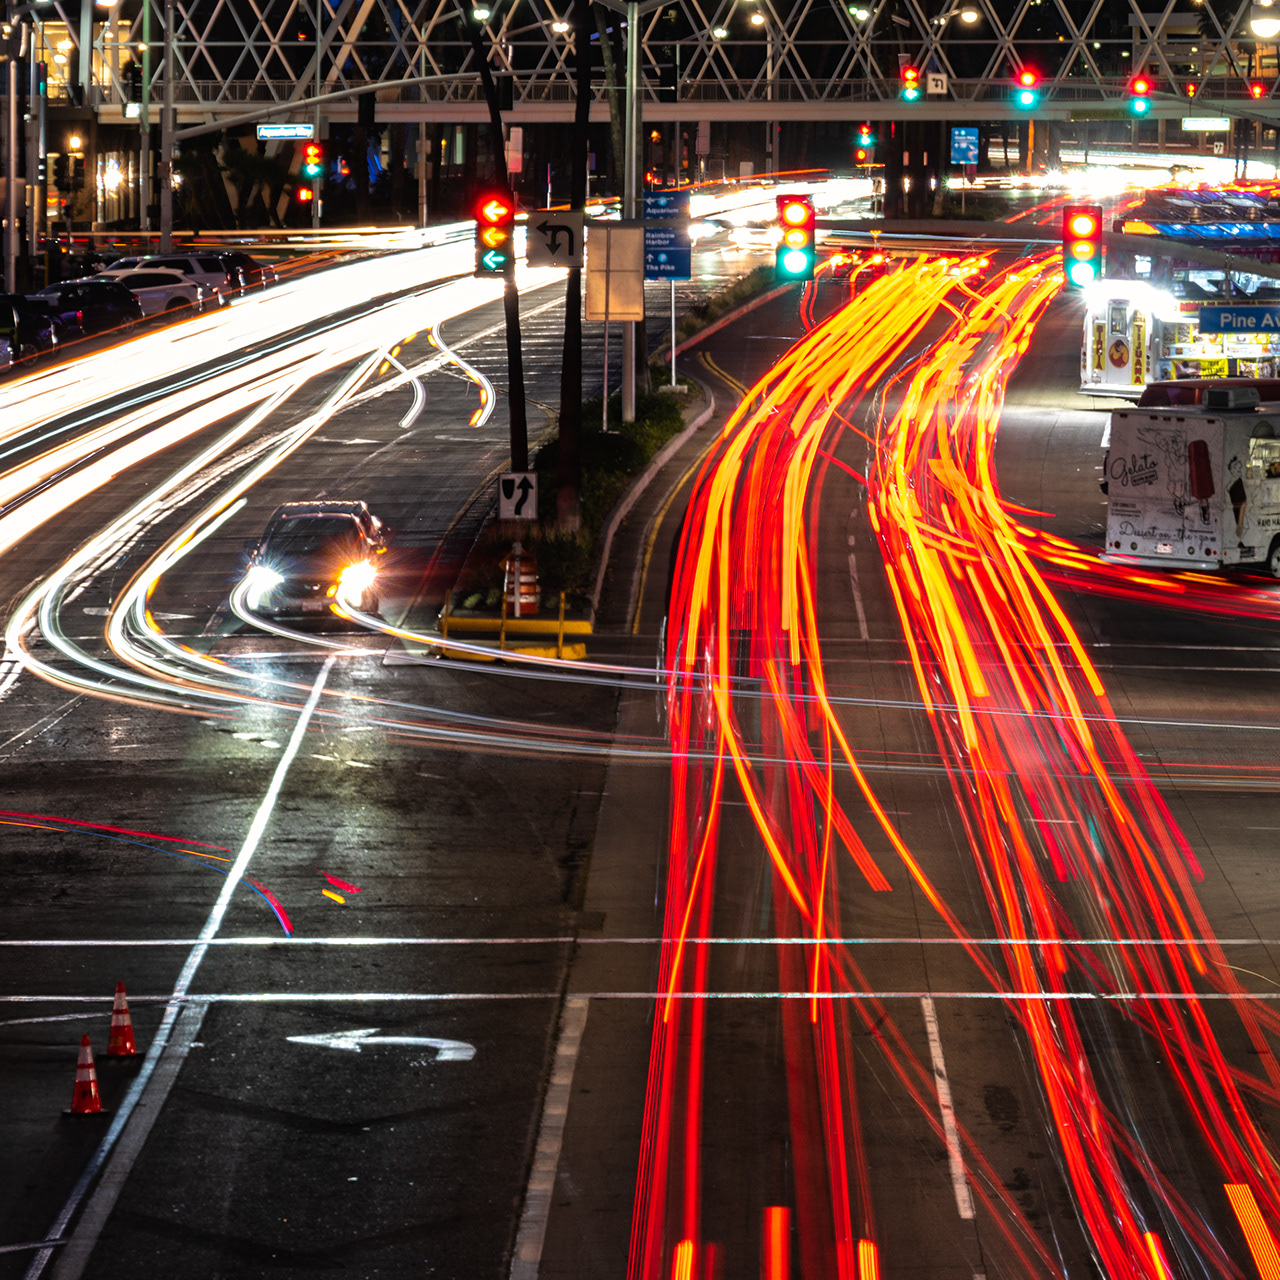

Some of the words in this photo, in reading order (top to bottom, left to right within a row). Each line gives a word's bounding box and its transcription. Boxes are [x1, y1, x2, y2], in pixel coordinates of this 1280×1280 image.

[1220, 313, 1256, 328] Pine
[1134, 325, 1143, 385] TIJUANA
[1111, 454, 1158, 487] Gelato
[1119, 521, 1157, 538] Dessert
